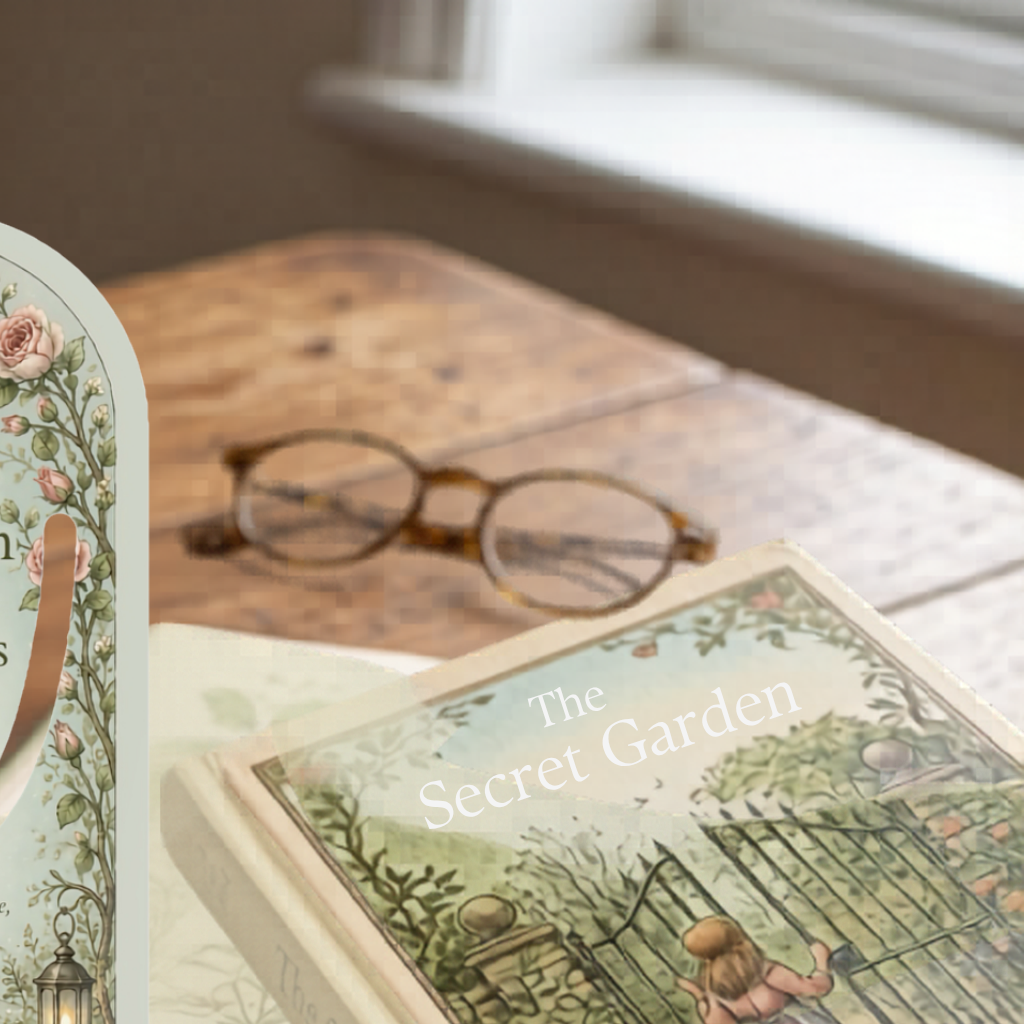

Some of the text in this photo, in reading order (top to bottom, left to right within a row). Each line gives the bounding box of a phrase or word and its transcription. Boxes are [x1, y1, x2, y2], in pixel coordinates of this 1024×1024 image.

[527, 685, 607, 728] The
[419, 681, 802, 830] Secret Garden
